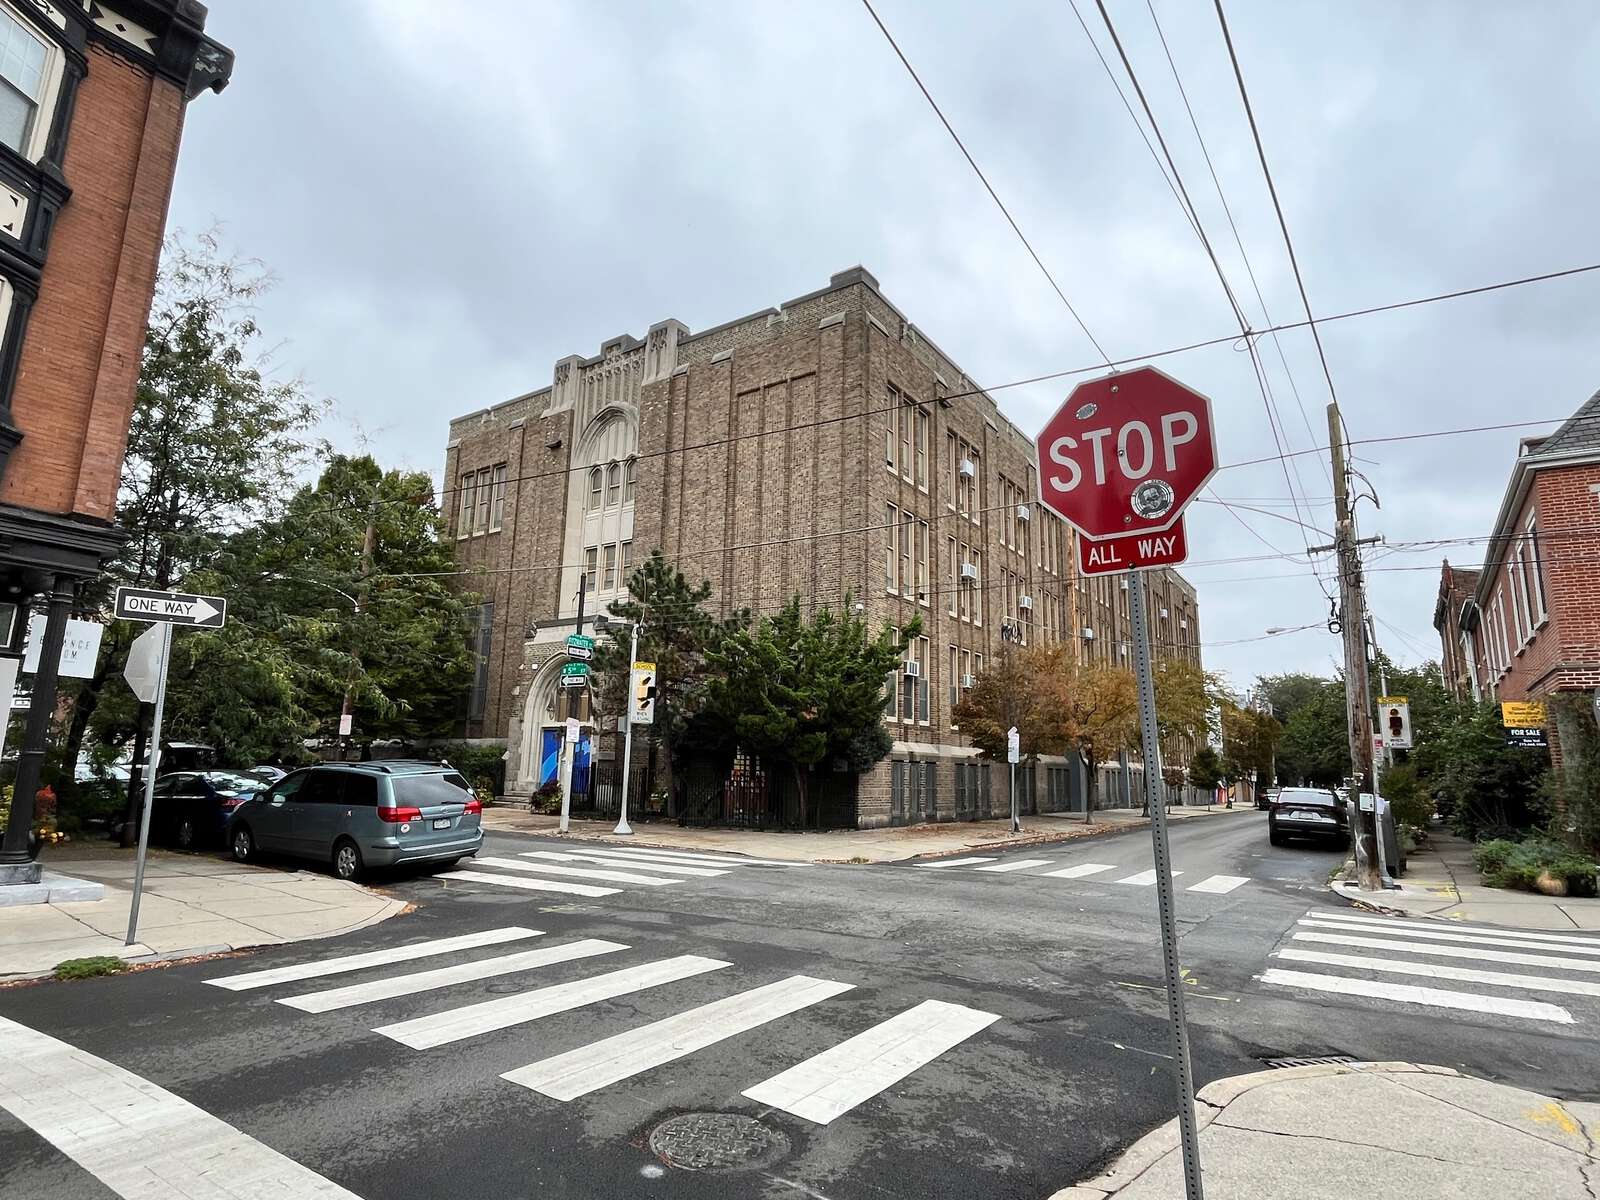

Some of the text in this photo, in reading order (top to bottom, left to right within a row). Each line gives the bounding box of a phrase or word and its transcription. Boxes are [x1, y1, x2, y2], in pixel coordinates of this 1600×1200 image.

[1049, 411, 1198, 493] STOP
[1088, 535, 1177, 566] ALL WAY
[129, 598, 194, 615] ONE WAY
